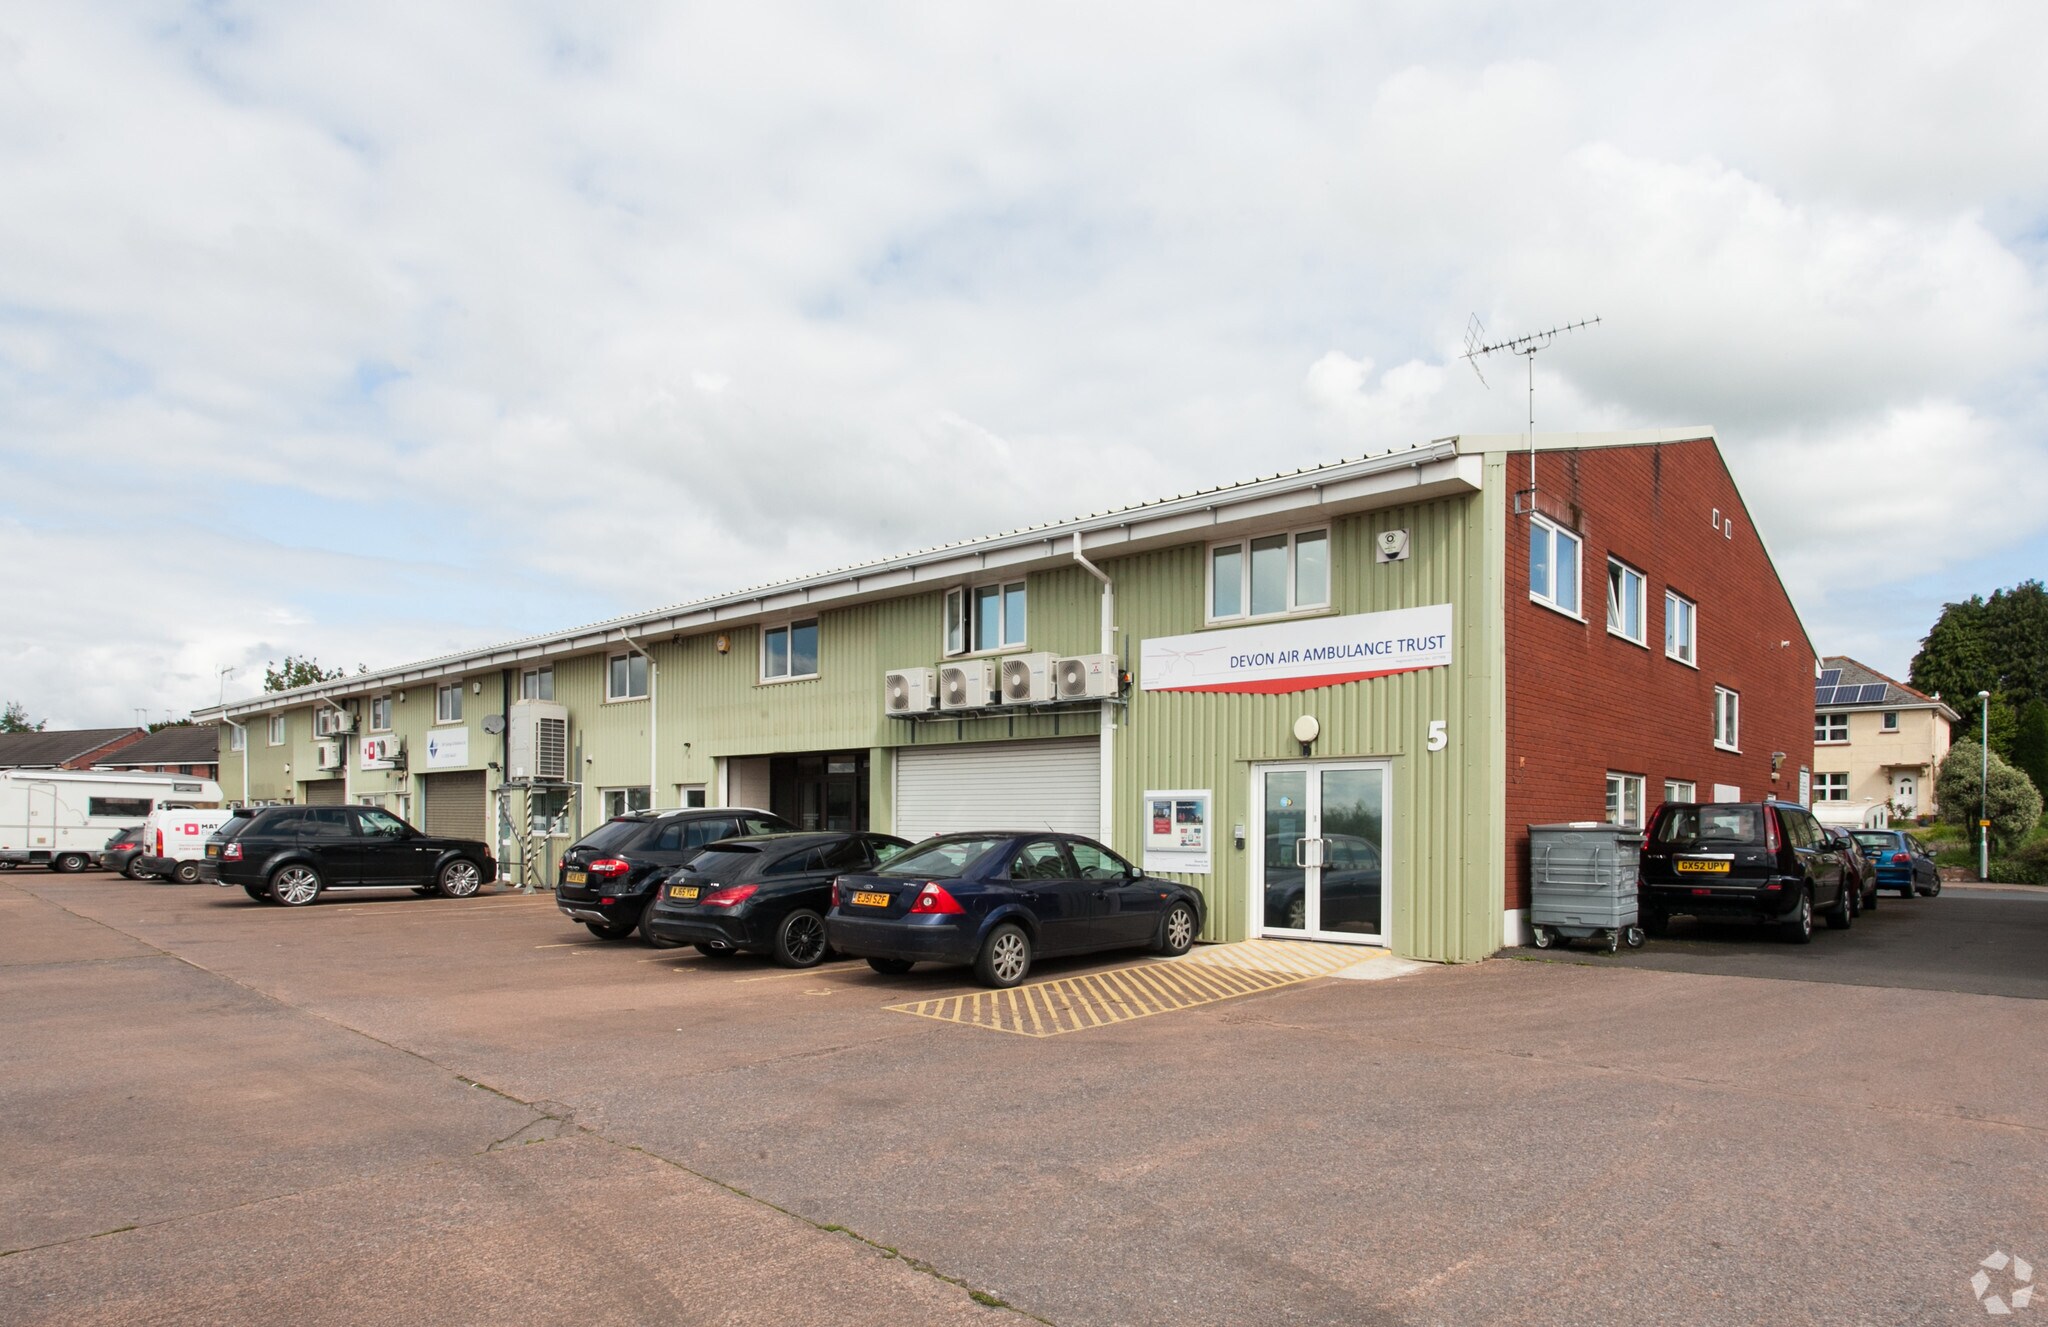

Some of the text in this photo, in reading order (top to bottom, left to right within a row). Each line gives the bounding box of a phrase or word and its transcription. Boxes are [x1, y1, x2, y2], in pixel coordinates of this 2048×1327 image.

[1230, 652, 1274, 668] DEVON
[1278, 649, 1299, 664] AIR
[1303, 640, 1393, 662] AMBULANCE
[1397, 635, 1446, 653] TRUST
[1427, 720, 1448, 751] 5
[1681, 861, 1726, 870] GX52 UPY
[857, 893, 887, 905] EJ51 SZF
